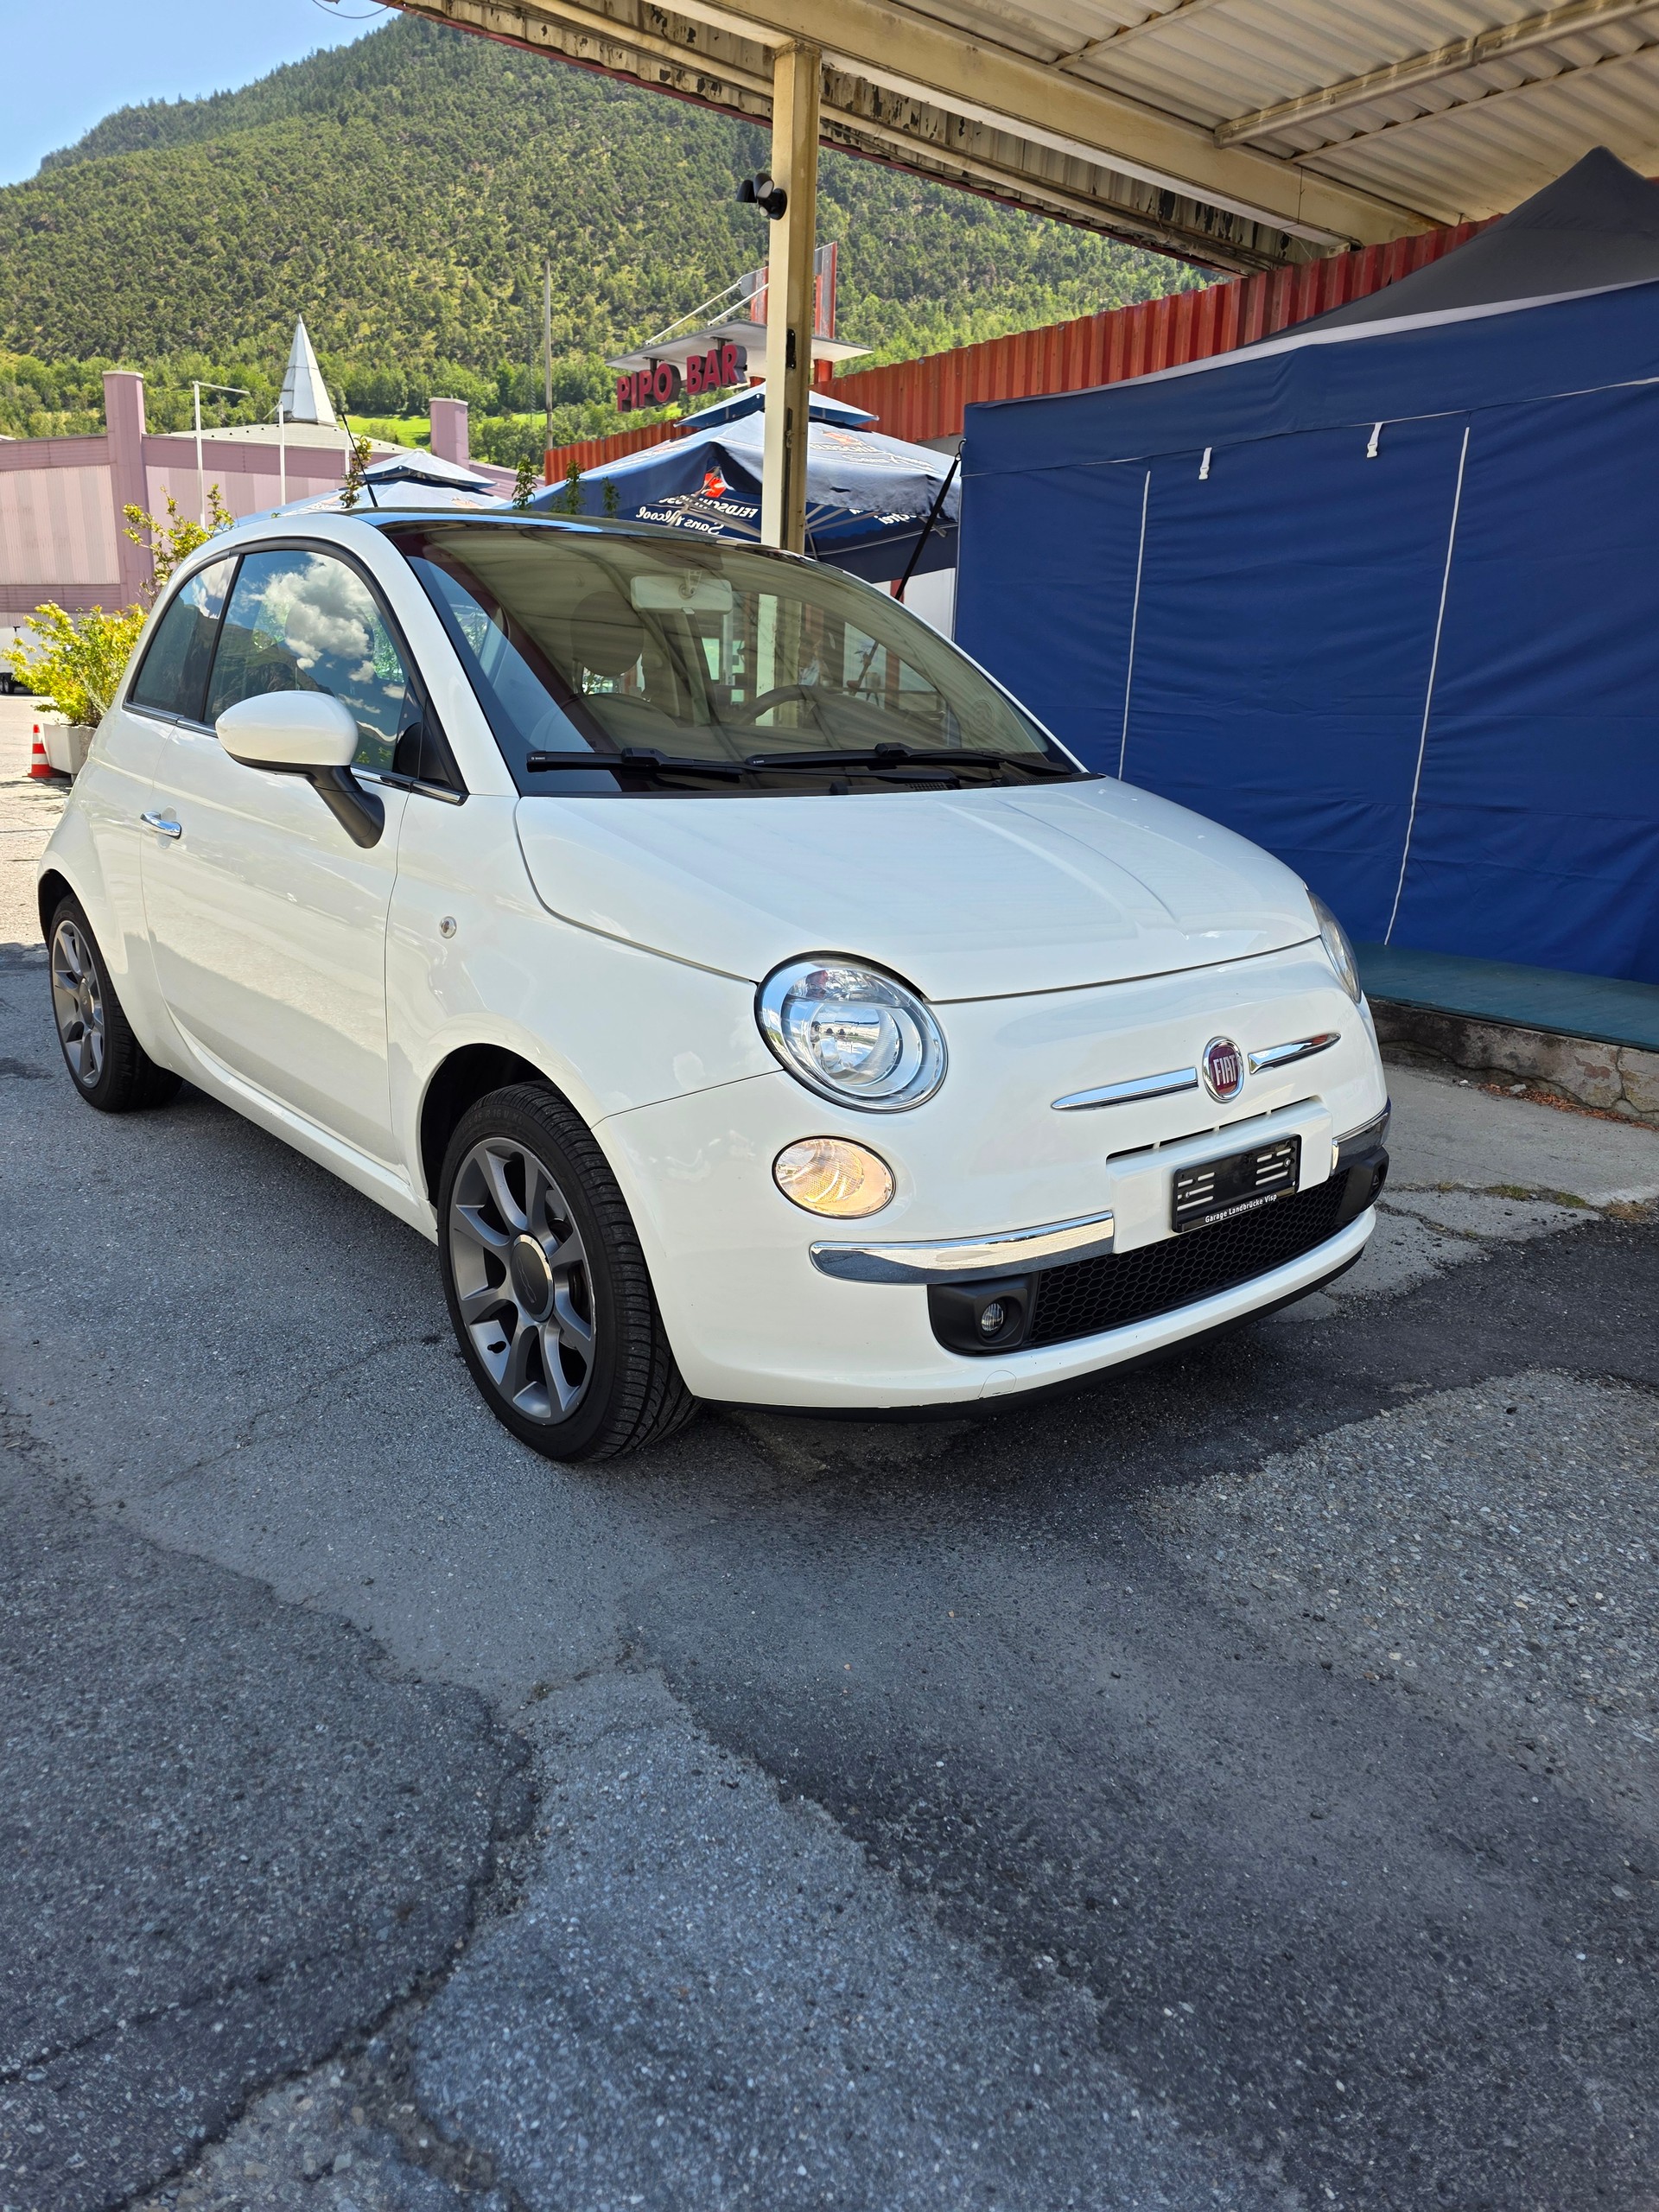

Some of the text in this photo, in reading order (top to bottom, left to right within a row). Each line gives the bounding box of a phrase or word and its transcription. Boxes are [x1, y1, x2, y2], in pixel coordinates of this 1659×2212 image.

[617, 344, 746, 412] PIPO BAR
[1213, 1055, 1237, 1086] FIAT
[1205, 1193, 1277, 1224] Garage Landbrücke Visp
